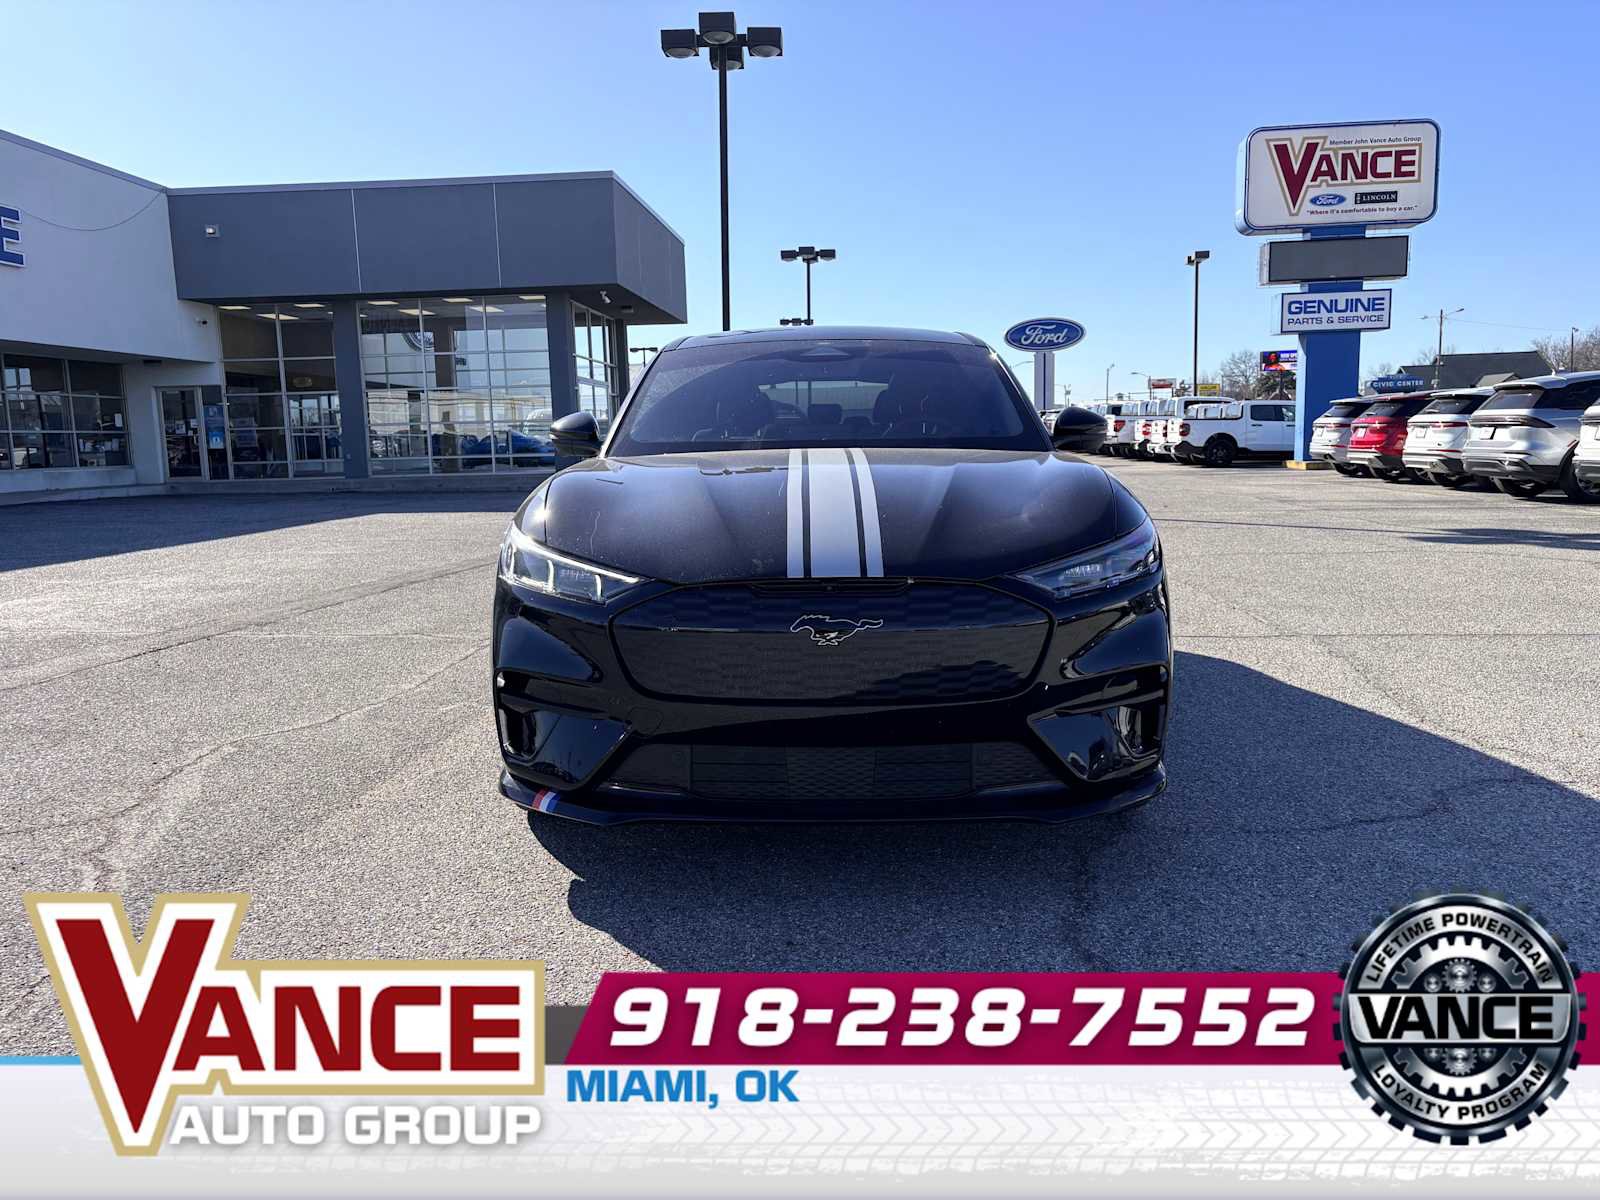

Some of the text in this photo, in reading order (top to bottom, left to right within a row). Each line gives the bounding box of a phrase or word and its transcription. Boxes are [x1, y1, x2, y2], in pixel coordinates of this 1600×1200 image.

[1273, 142, 1417, 209] VANCE
[1316, 195, 1340, 205] Ford
[1362, 193, 1396, 201] LINCOLN
[1340, 206, 1378, 214] comfortable
[1386, 205, 1397, 213] buy
[1287, 297, 1385, 315] GENUINE
[1287, 314, 1385, 326] PARTS & SERVICE
[1021, 324, 1068, 345] Ford
